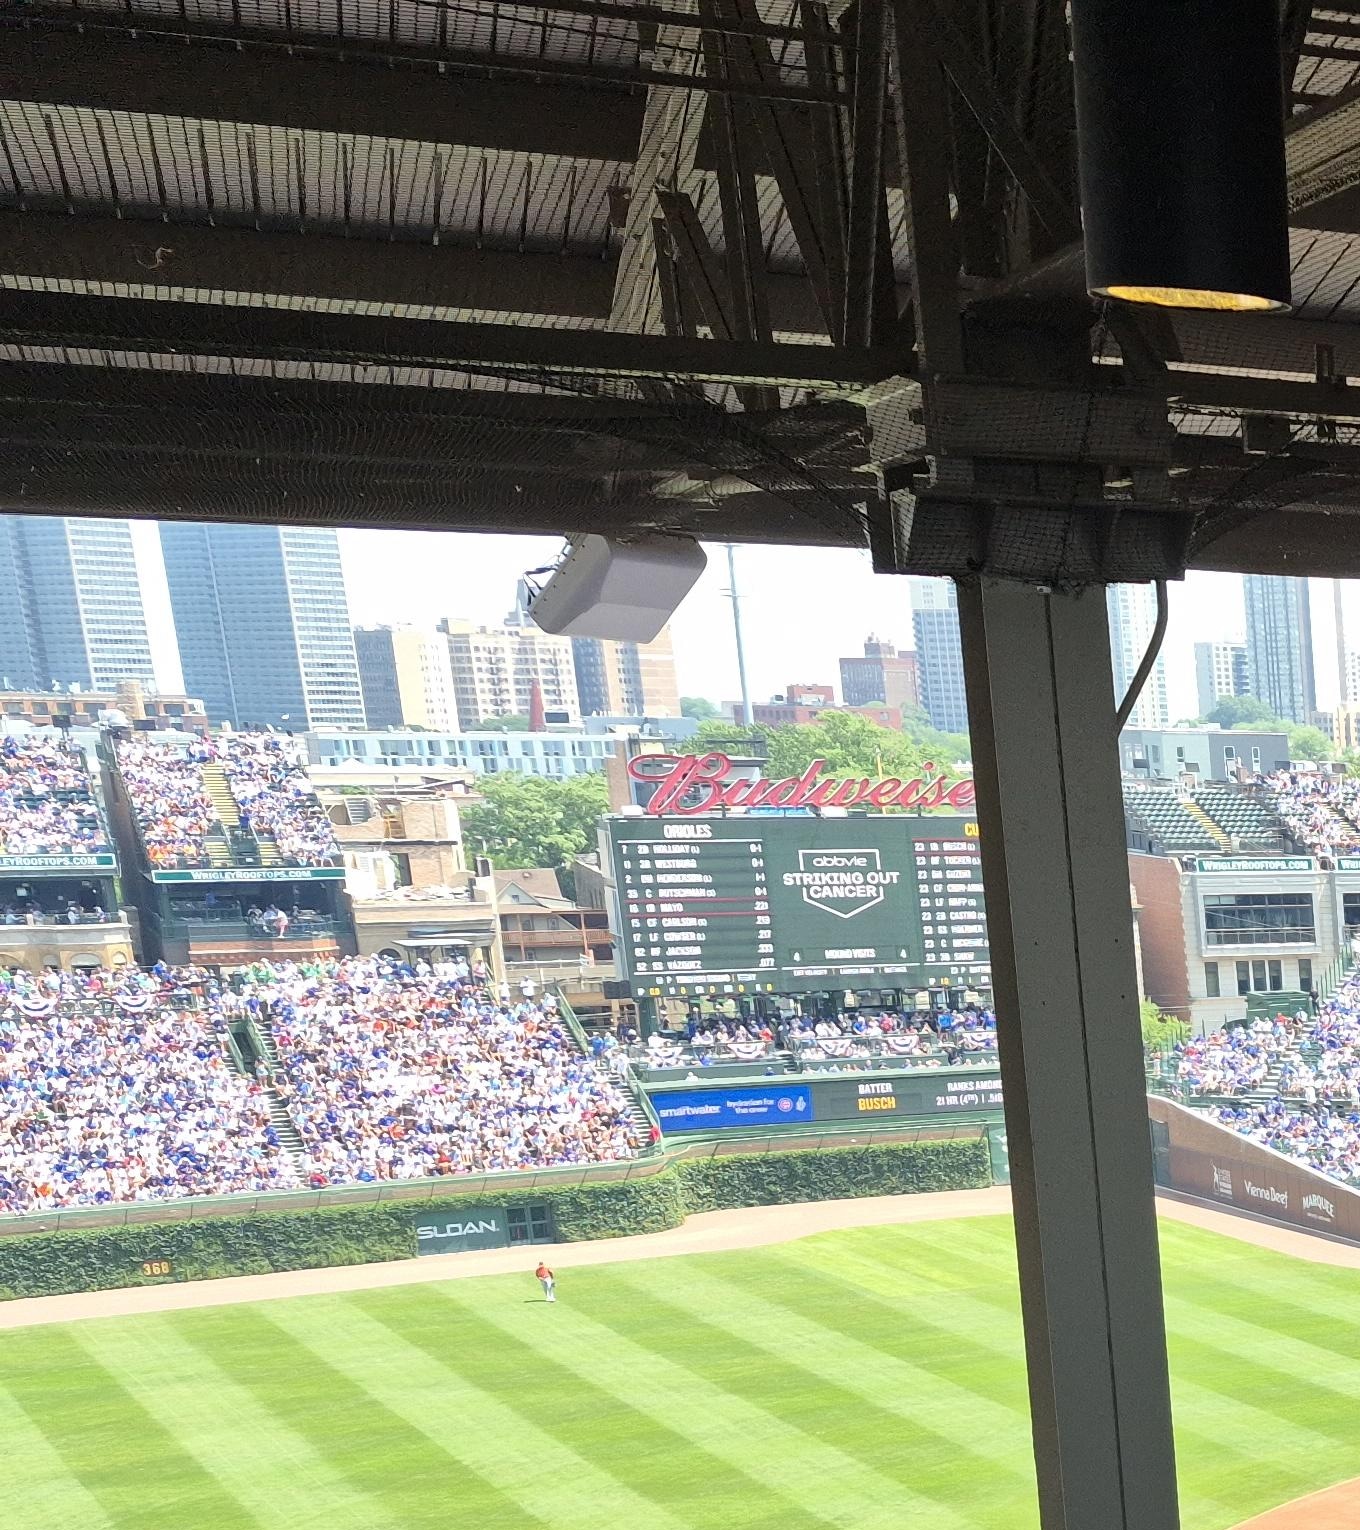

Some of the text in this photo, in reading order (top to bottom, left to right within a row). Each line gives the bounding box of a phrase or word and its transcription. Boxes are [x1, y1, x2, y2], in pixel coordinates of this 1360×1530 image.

[664, 824, 712, 838] ORIOLES
[653, 845, 690, 854] HOLLIDAY
[813, 855, 867, 867] abbvie
[783, 871, 900, 885] STRIKING OUT
[810, 885, 878, 898] CANCER
[660, 903, 684, 912] MAYO
[858, 1082, 893, 1095] BATTER
[726, 1097, 775, 1108] hydration for
[858, 1096, 896, 1111] BUSCH
[660, 1104, 721, 1118] smartwater
[1244, 1179, 1270, 1200] Vienna
[1270, 1186, 1288, 1209] Beef
[1302, 1194, 1335, 1218] MARQUEE
[417, 1219, 496, 1240] SLOAN
[143, 1261, 170, 1276] 368
